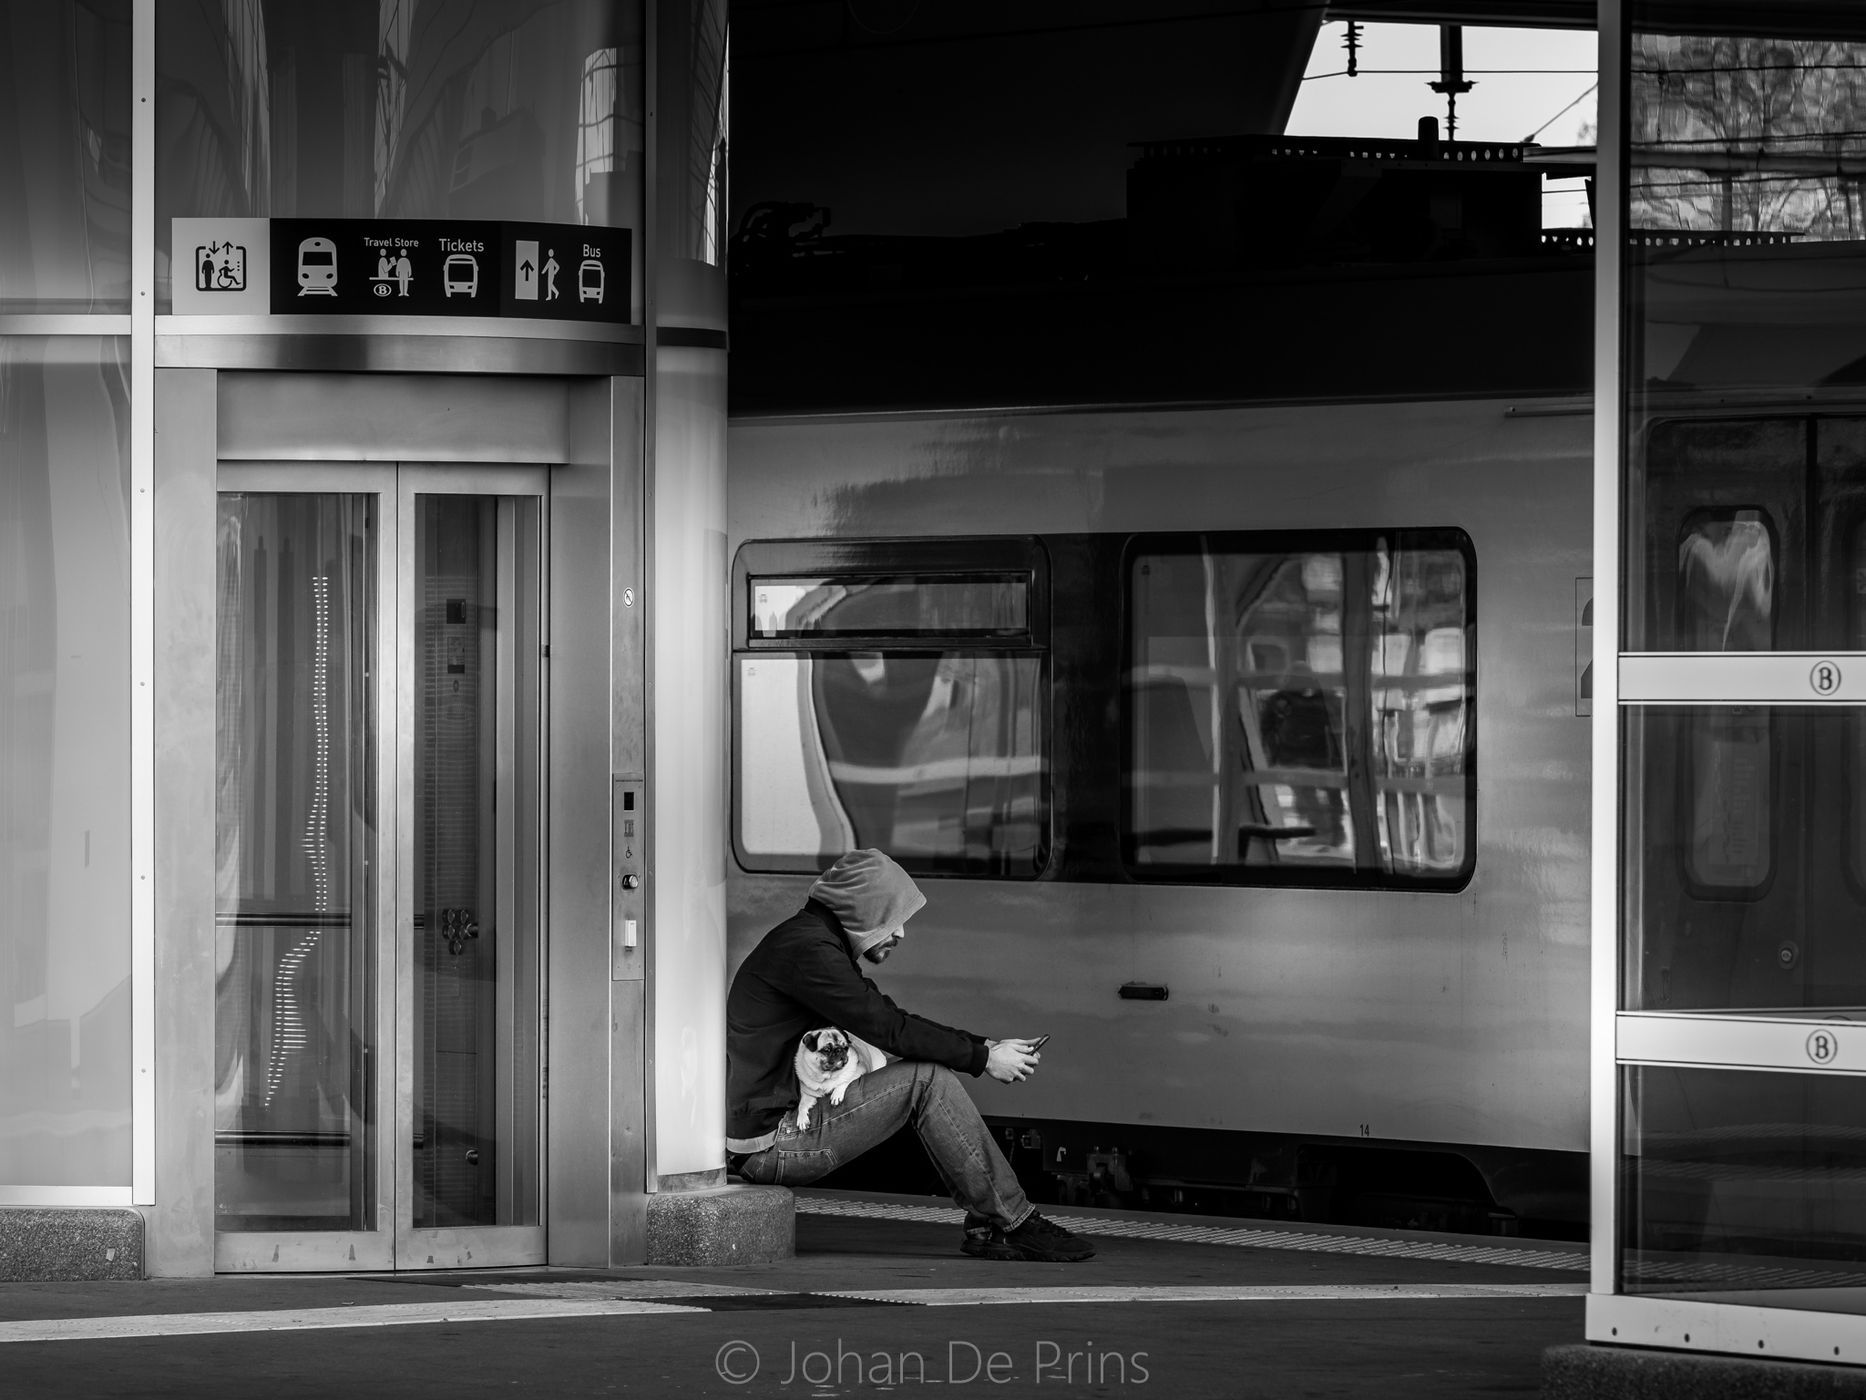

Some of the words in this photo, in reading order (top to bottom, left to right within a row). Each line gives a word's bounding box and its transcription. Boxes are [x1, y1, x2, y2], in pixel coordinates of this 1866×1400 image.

[364, 237, 392, 249] Travel
[394, 237, 419, 249] Store
[438, 238, 485, 253] Tickets
[582, 243, 602, 258] Bus
[1359, 1124, 1370, 1137] 14
